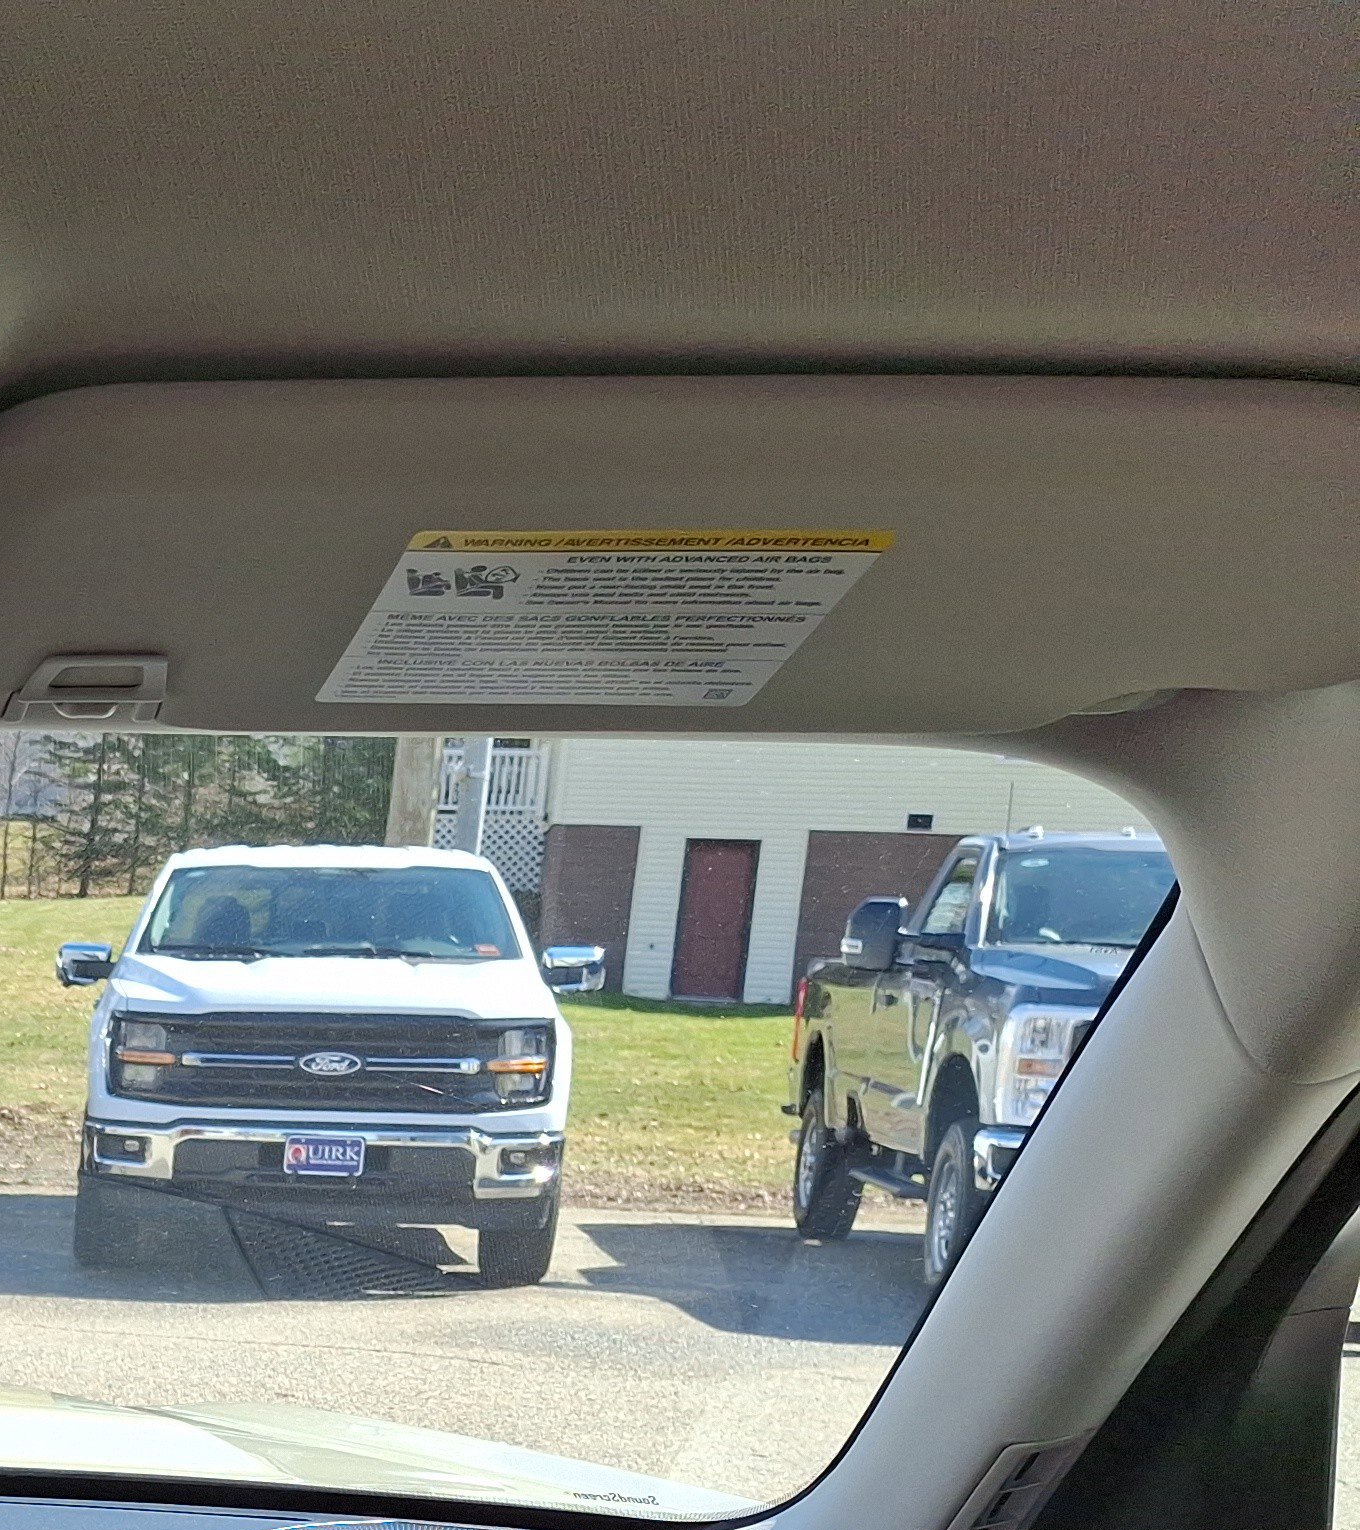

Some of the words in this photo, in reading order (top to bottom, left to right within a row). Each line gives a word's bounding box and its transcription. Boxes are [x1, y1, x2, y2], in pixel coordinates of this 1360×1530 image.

[463, 538, 551, 547] WARNING
[567, 556, 613, 564] EVEN
[616, 556, 656, 564] WITH
[659, 556, 750, 564] ADVANCED
[753, 556, 782, 564] AIR
[784, 556, 833, 564] BAGS
[287, 1144, 361, 1165] QUIRK
